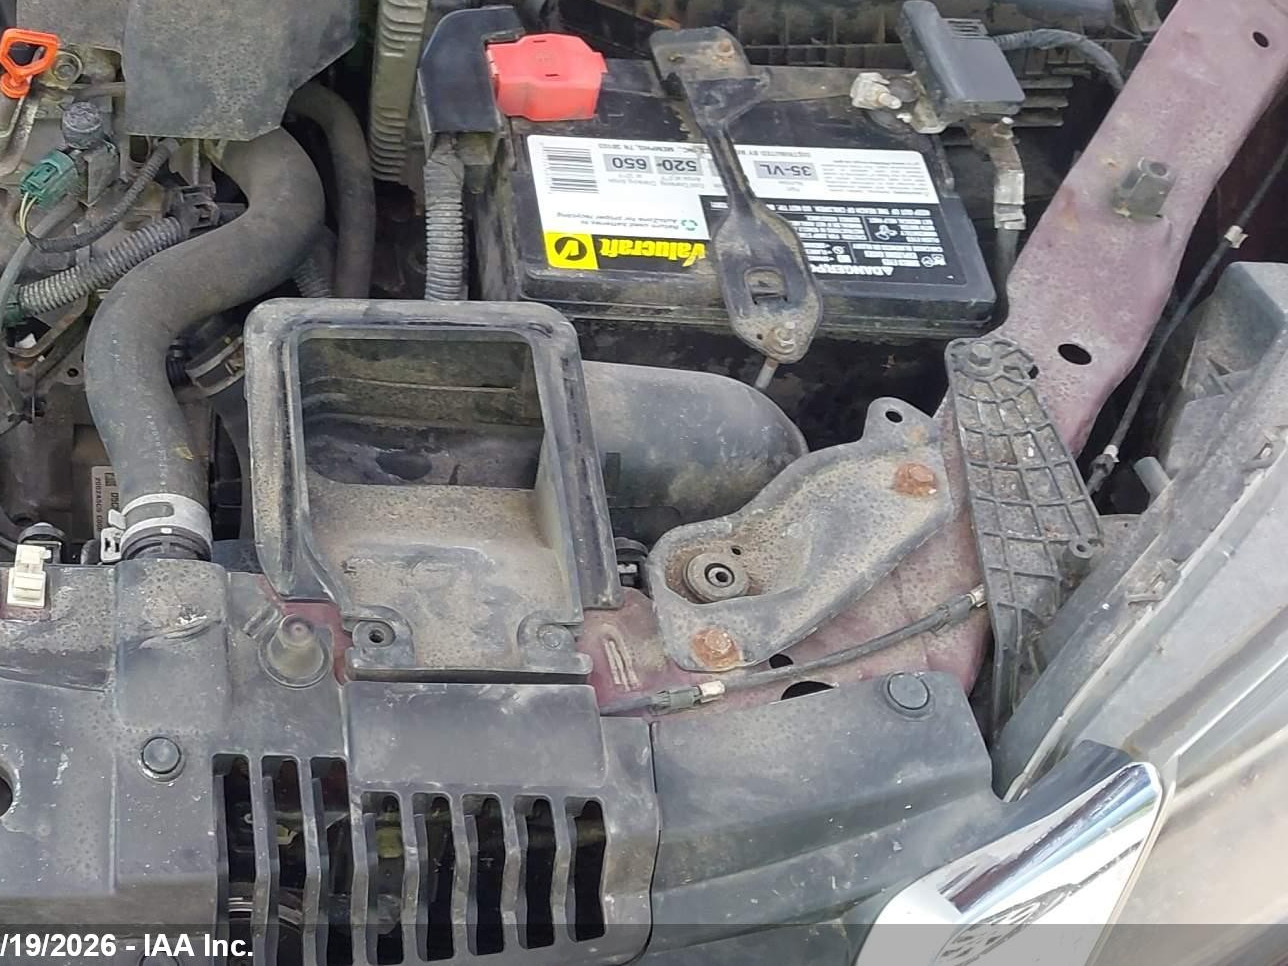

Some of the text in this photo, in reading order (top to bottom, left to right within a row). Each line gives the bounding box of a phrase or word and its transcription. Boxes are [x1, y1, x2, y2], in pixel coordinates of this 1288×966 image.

[612, 157, 647, 170] 650
[759, 164, 812, 177] 35-VL
[599, 238, 707, 267] Valucraft
